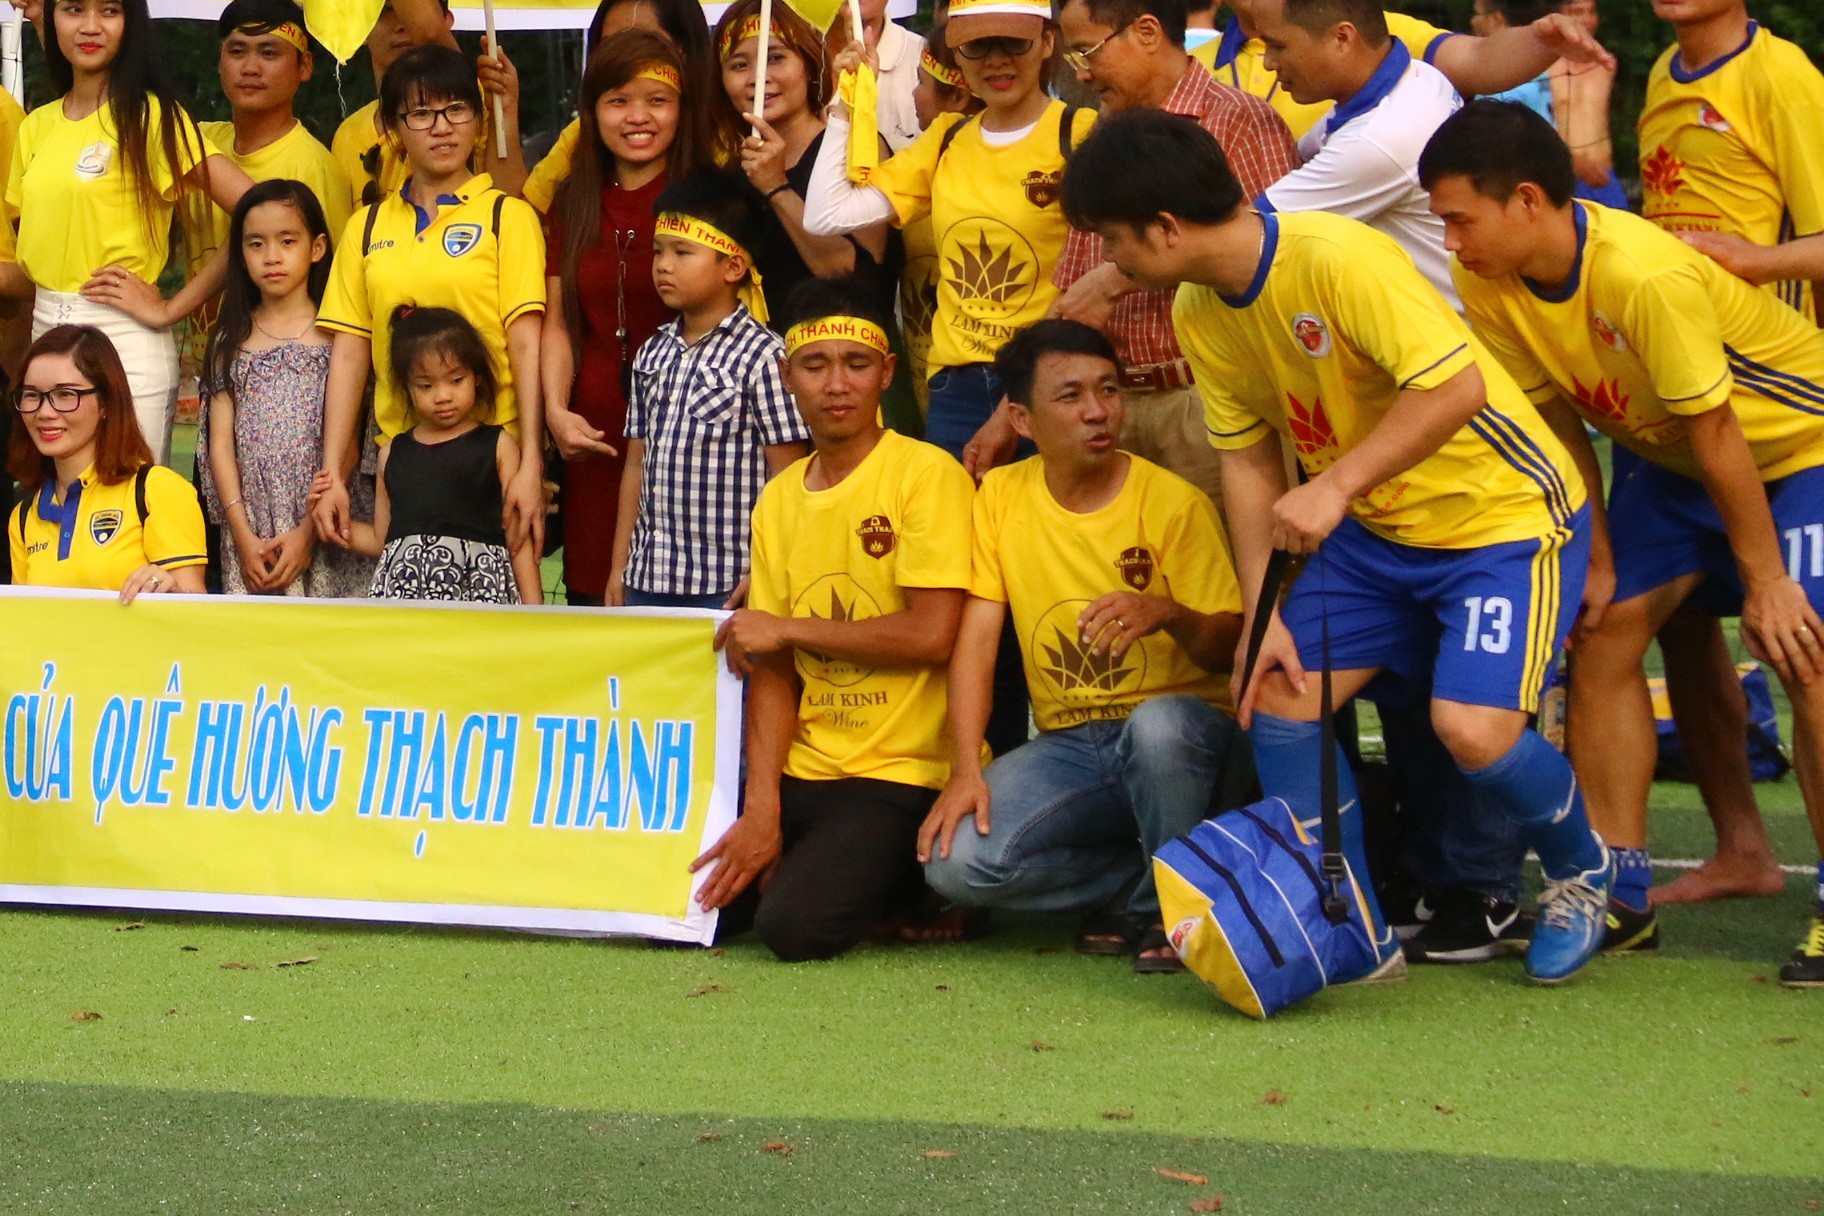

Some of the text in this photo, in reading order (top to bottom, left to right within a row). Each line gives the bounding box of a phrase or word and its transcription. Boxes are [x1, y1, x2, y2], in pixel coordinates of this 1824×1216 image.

[369, 239, 394, 253] mitre
[27, 541, 49, 555] mitre
[1464, 596, 1512, 654] 13
[807, 691, 888, 706] LAM KINH
[1056, 710, 1092, 725] LAM
[3, 662, 74, 803] CỦA
[91, 661, 183, 824] QUÊ
[185, 683, 344, 814] HƯƠNG
[356, 707, 520, 859] THẠCH
[531, 675, 696, 834] THÀNH
